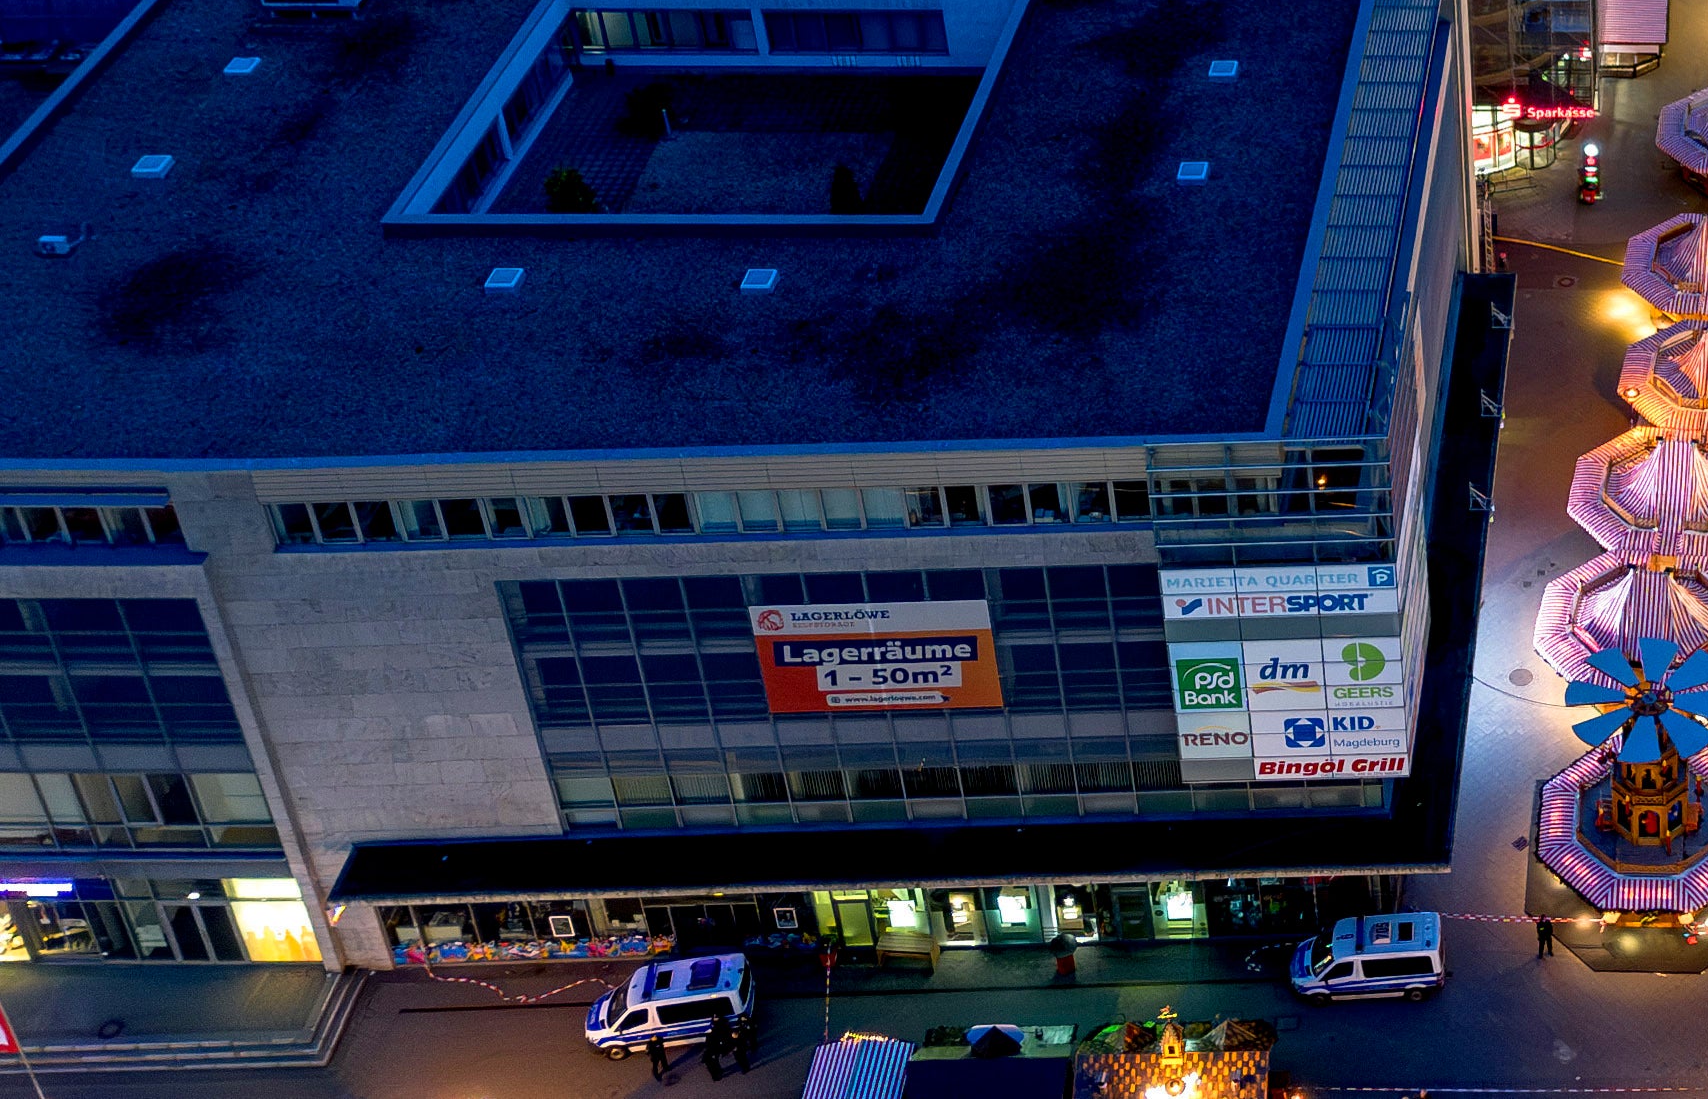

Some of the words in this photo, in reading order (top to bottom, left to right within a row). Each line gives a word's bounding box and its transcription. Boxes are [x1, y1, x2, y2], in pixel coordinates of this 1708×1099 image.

[1527, 107, 1595, 119] Sparkasse
[1166, 575, 1258, 589] MARIETTA
[1266, 573, 1358, 587] QUARTIER
[1375, 574, 1388, 585] P
[1207, 593, 1369, 614] INTERSPORT
[790, 609, 890, 622] LAGERLÖWE
[783, 641, 972, 666] Lagerräume
[1259, 657, 1310, 680] dm
[823, 669, 838, 687] 1
[1194, 671, 1235, 690] psd
[1184, 690, 1238, 705] Bank
[1332, 686, 1395, 700] GEERS
[1332, 716, 1375, 731] KID
[1182, 731, 1249, 747] RENO
[1333, 738, 1401, 749] Magdeburg
[1351, 757, 1405, 773] Grill
